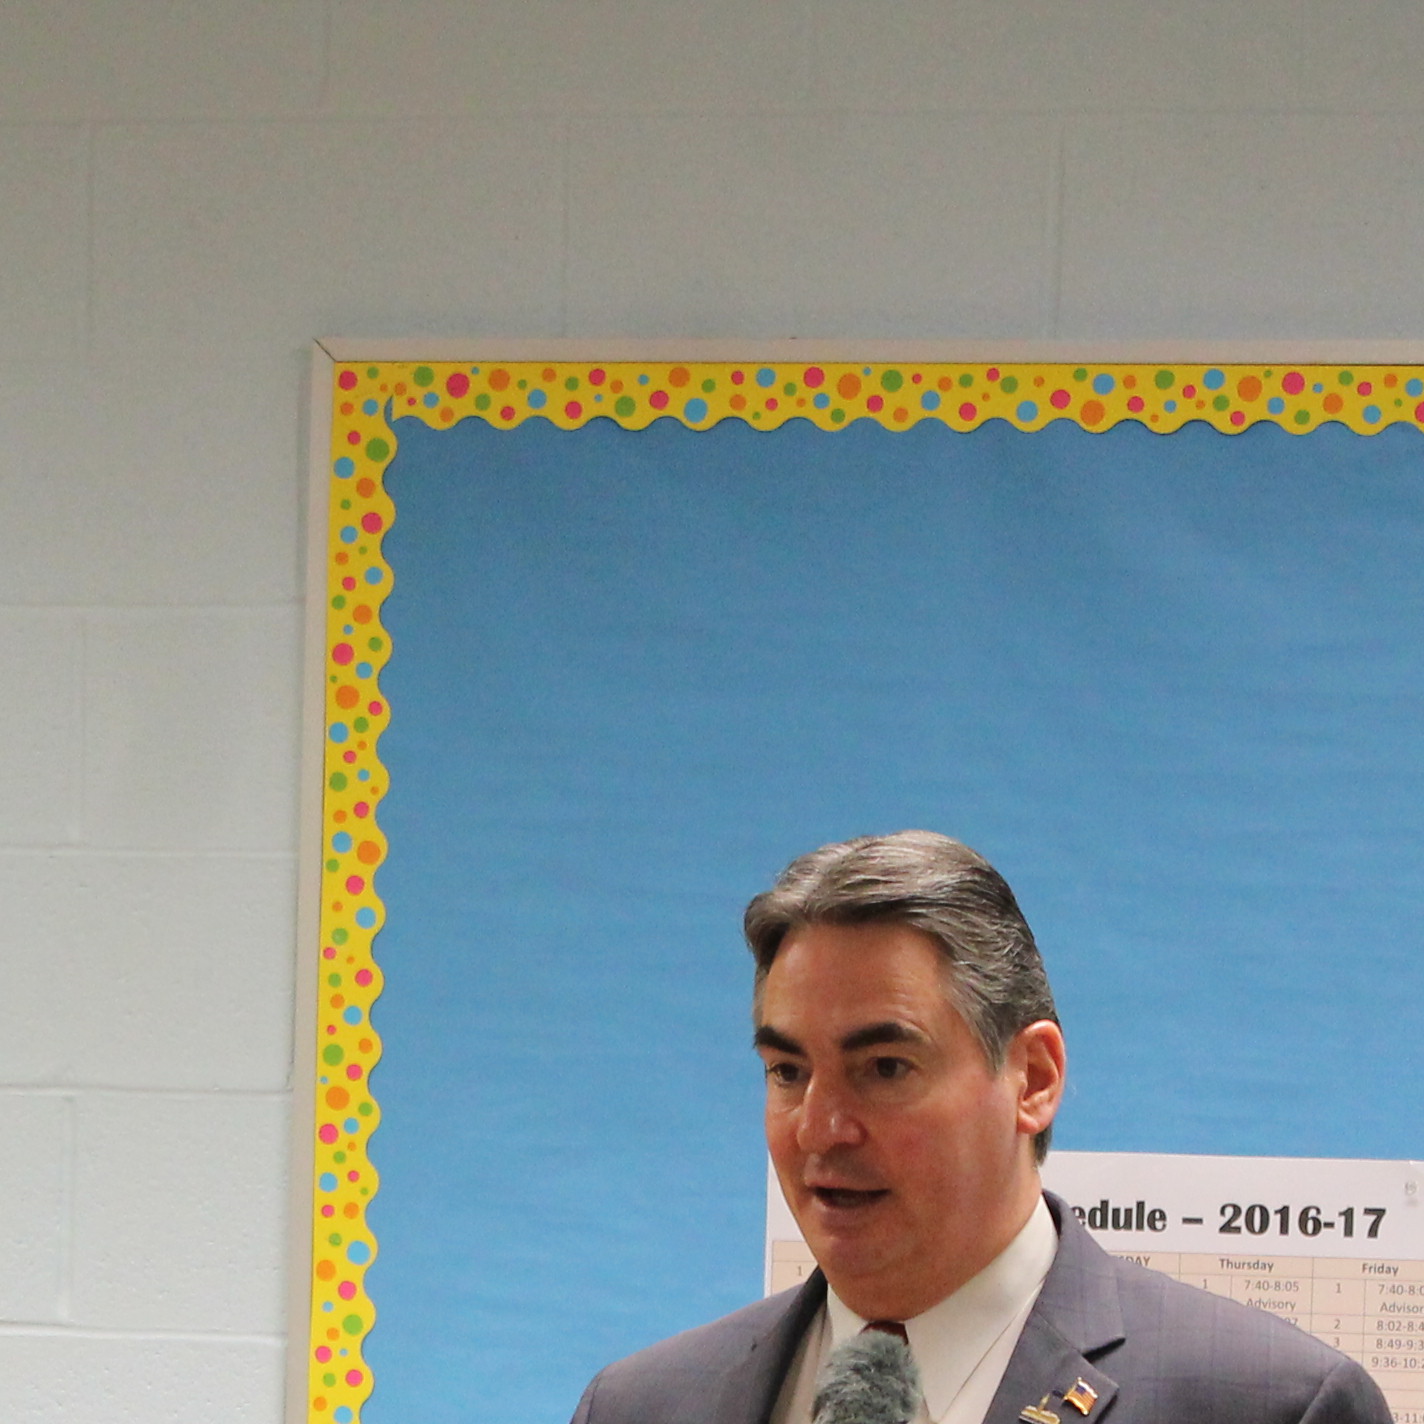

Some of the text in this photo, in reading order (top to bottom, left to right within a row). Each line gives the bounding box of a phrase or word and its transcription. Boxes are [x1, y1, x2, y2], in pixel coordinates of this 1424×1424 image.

[1218, 1202, 1387, 1239] 2016-17
[797, 1266, 803, 1276] 1
[1219, 1258, 1275, 1273] Thursday
[1361, 1263, 1400, 1277] Friday
[1202, 1279, 1300, 1292] 1 7:40-8:05
[1335, 1282, 1342, 1294] 1
[1246, 1298, 1297, 1312] Advisory
[1333, 1318, 1341, 1330] 2
[1333, 1337, 1341, 1348] 3
